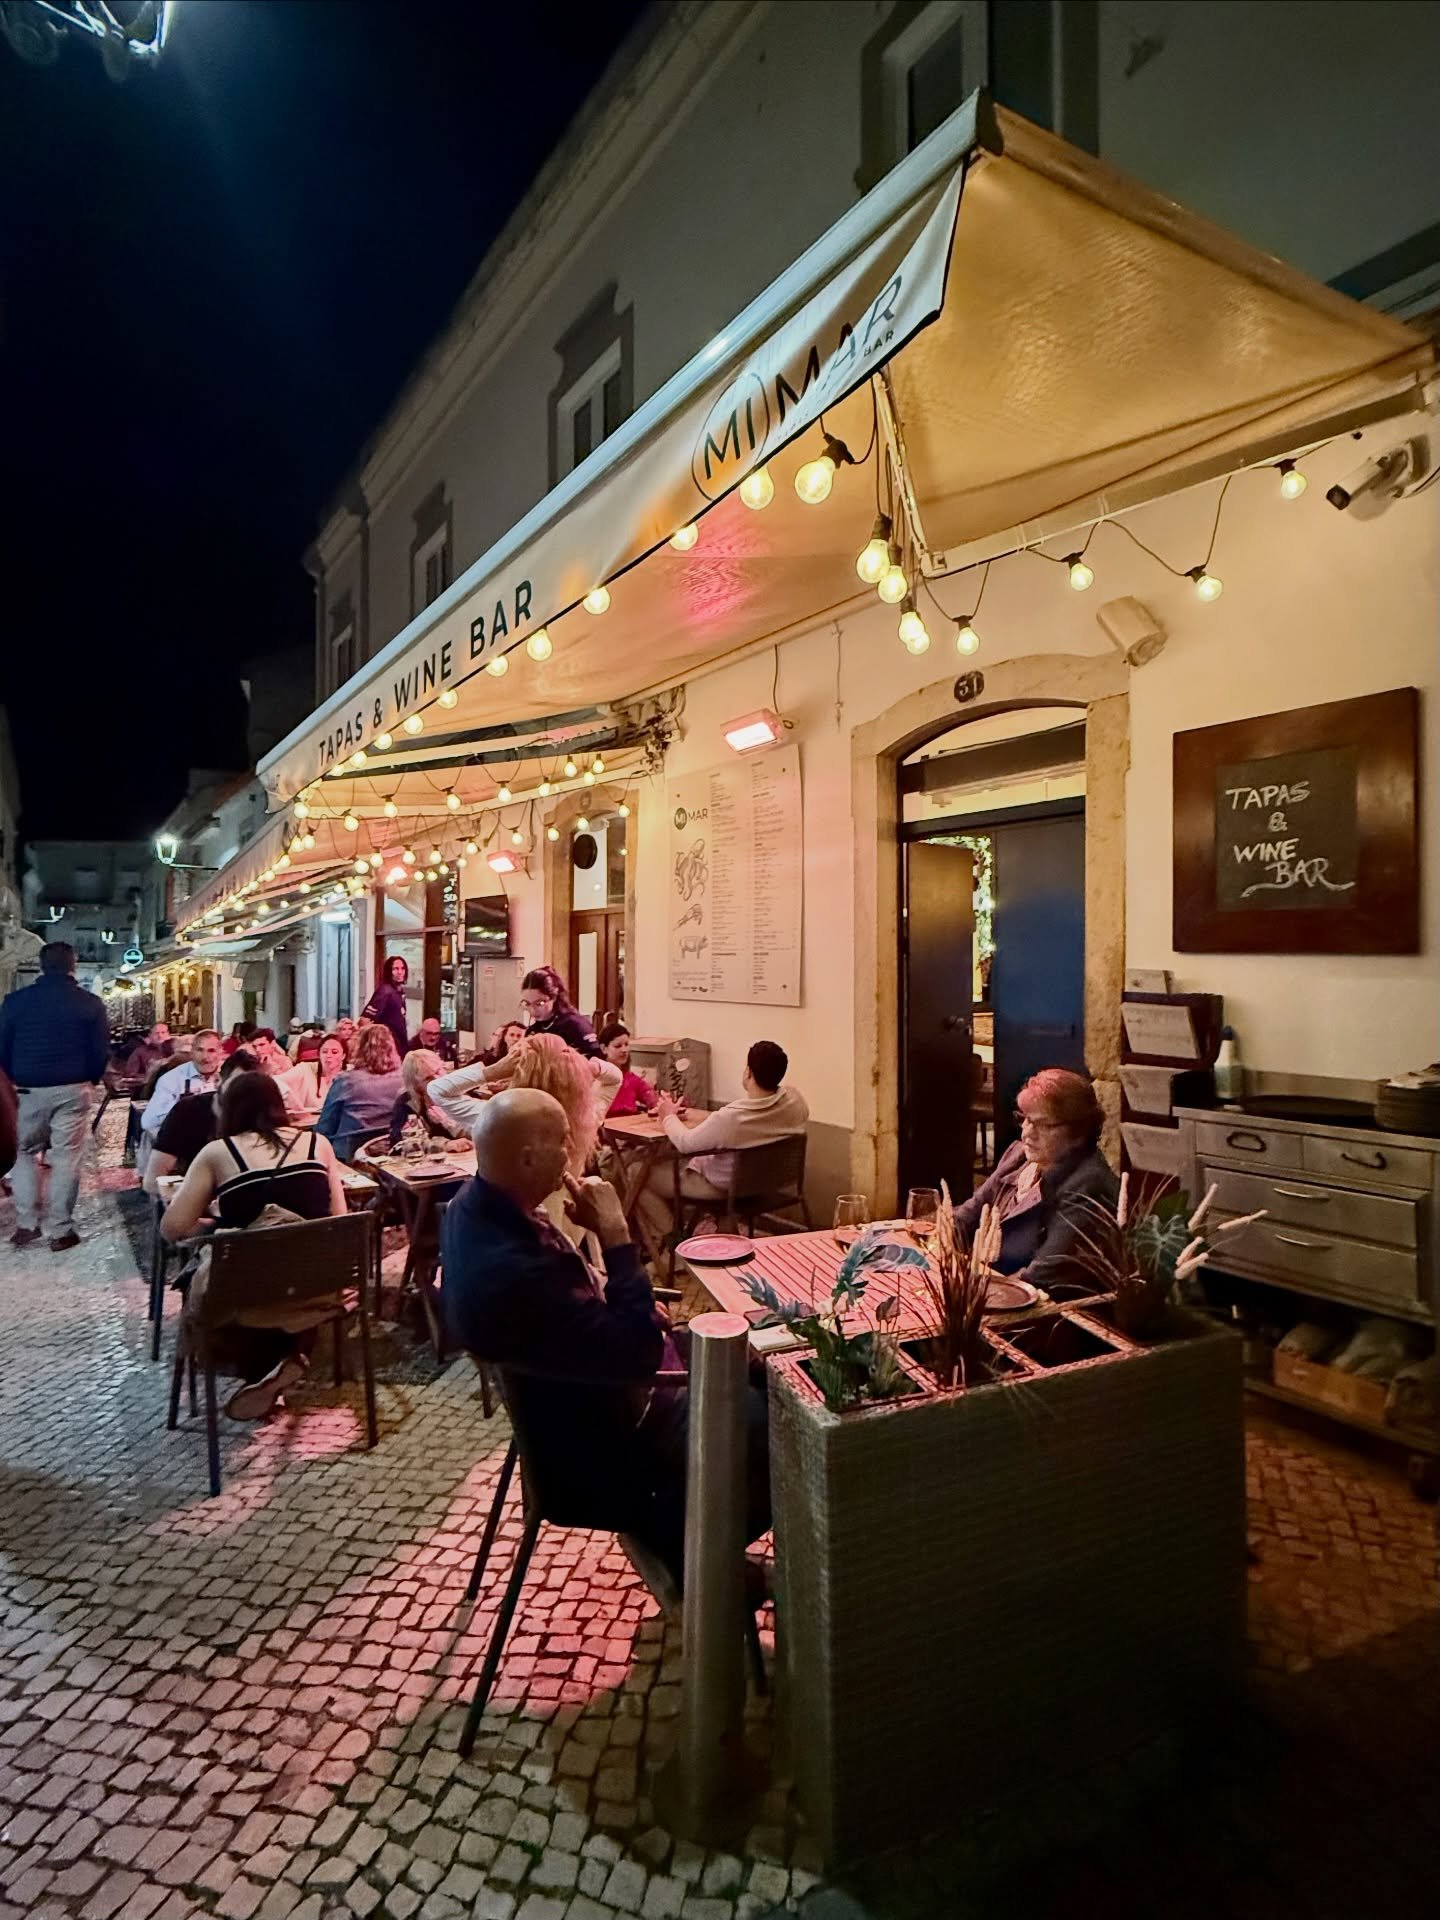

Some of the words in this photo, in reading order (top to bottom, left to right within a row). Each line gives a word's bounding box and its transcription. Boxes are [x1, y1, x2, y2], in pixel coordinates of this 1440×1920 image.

[318, 711, 363, 767] TAPAS
[372, 697, 383, 729] &
[393, 639, 453, 713] WINE
[469, 579, 533, 661] BAR
[1225, 780, 1312, 810] TAPAS
[1267, 811, 1289, 832] &
[1233, 837, 1301, 864] WINE
[1260, 857, 1355, 890] BAR
